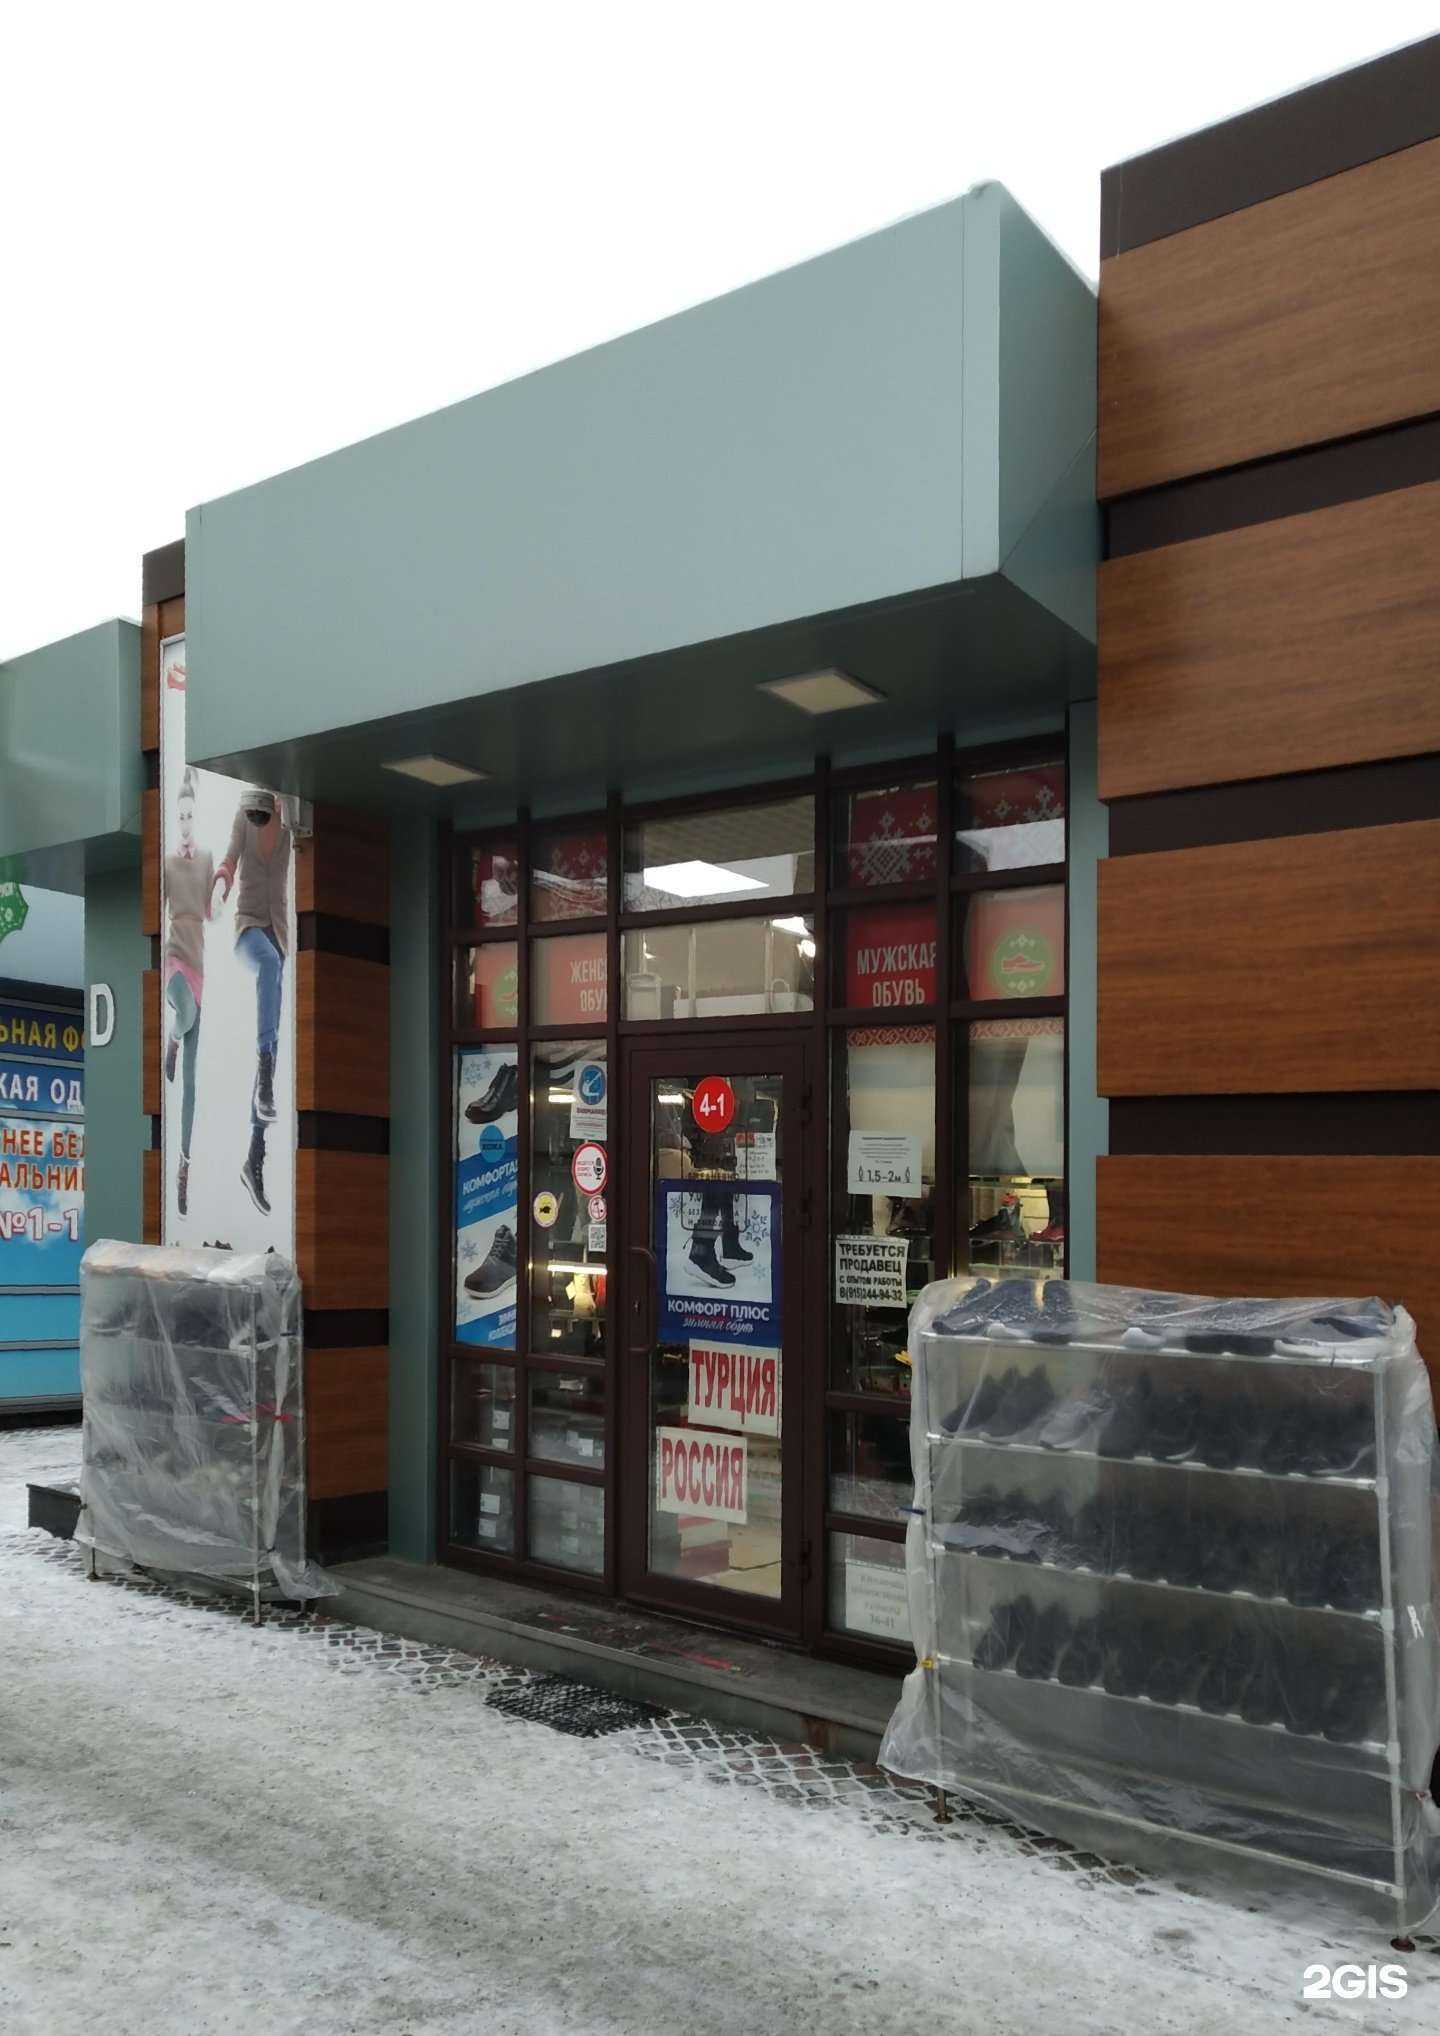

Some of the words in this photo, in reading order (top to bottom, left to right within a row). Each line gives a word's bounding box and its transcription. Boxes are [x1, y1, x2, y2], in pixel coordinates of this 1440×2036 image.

[857, 941, 936, 975] МУЖСКАЯ
[873, 978, 925, 1007] ОБУВЬ
[90, 983, 114, 1047] D
[700, 1093, 725, 1117] 4-1
[3, 1129, 43, 1156] НЕЕ
[839, 1244, 906, 1257] ТРЕБУЕТСЯ
[840, 1259, 901, 1275] ПРОДАВЕЦ
[668, 1299, 728, 1316] КОМФОРТ
[731, 1305, 770, 1321] ПЛЮС
[692, 1350, 776, 1424] ТУРЦИЯ
[662, 1438, 744, 1510] РОССИЯ
